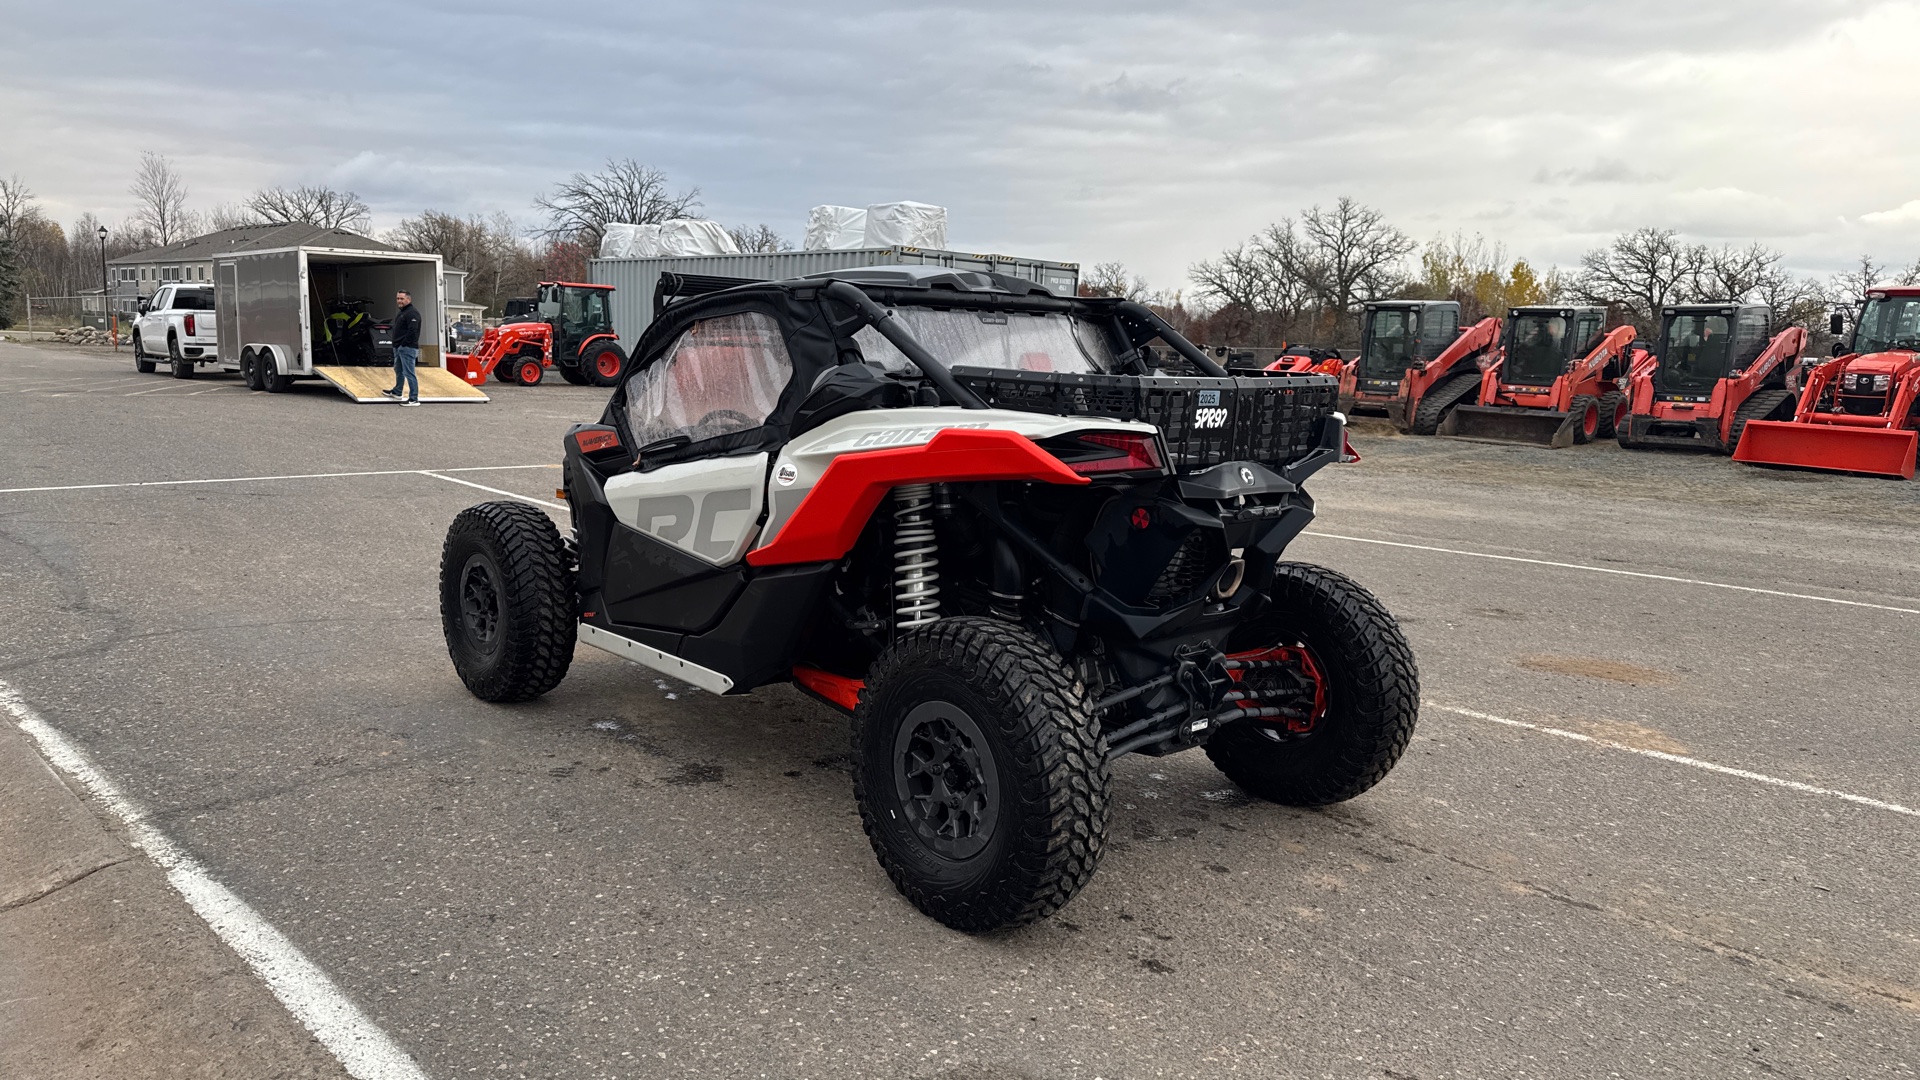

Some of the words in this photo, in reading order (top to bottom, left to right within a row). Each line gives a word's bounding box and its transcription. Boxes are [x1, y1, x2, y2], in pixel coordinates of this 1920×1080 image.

[1588, 348, 1608, 370] KUBOTA
[1200, 394, 1216, 404] 2025
[1194, 407, 1228, 429] 5PR97
